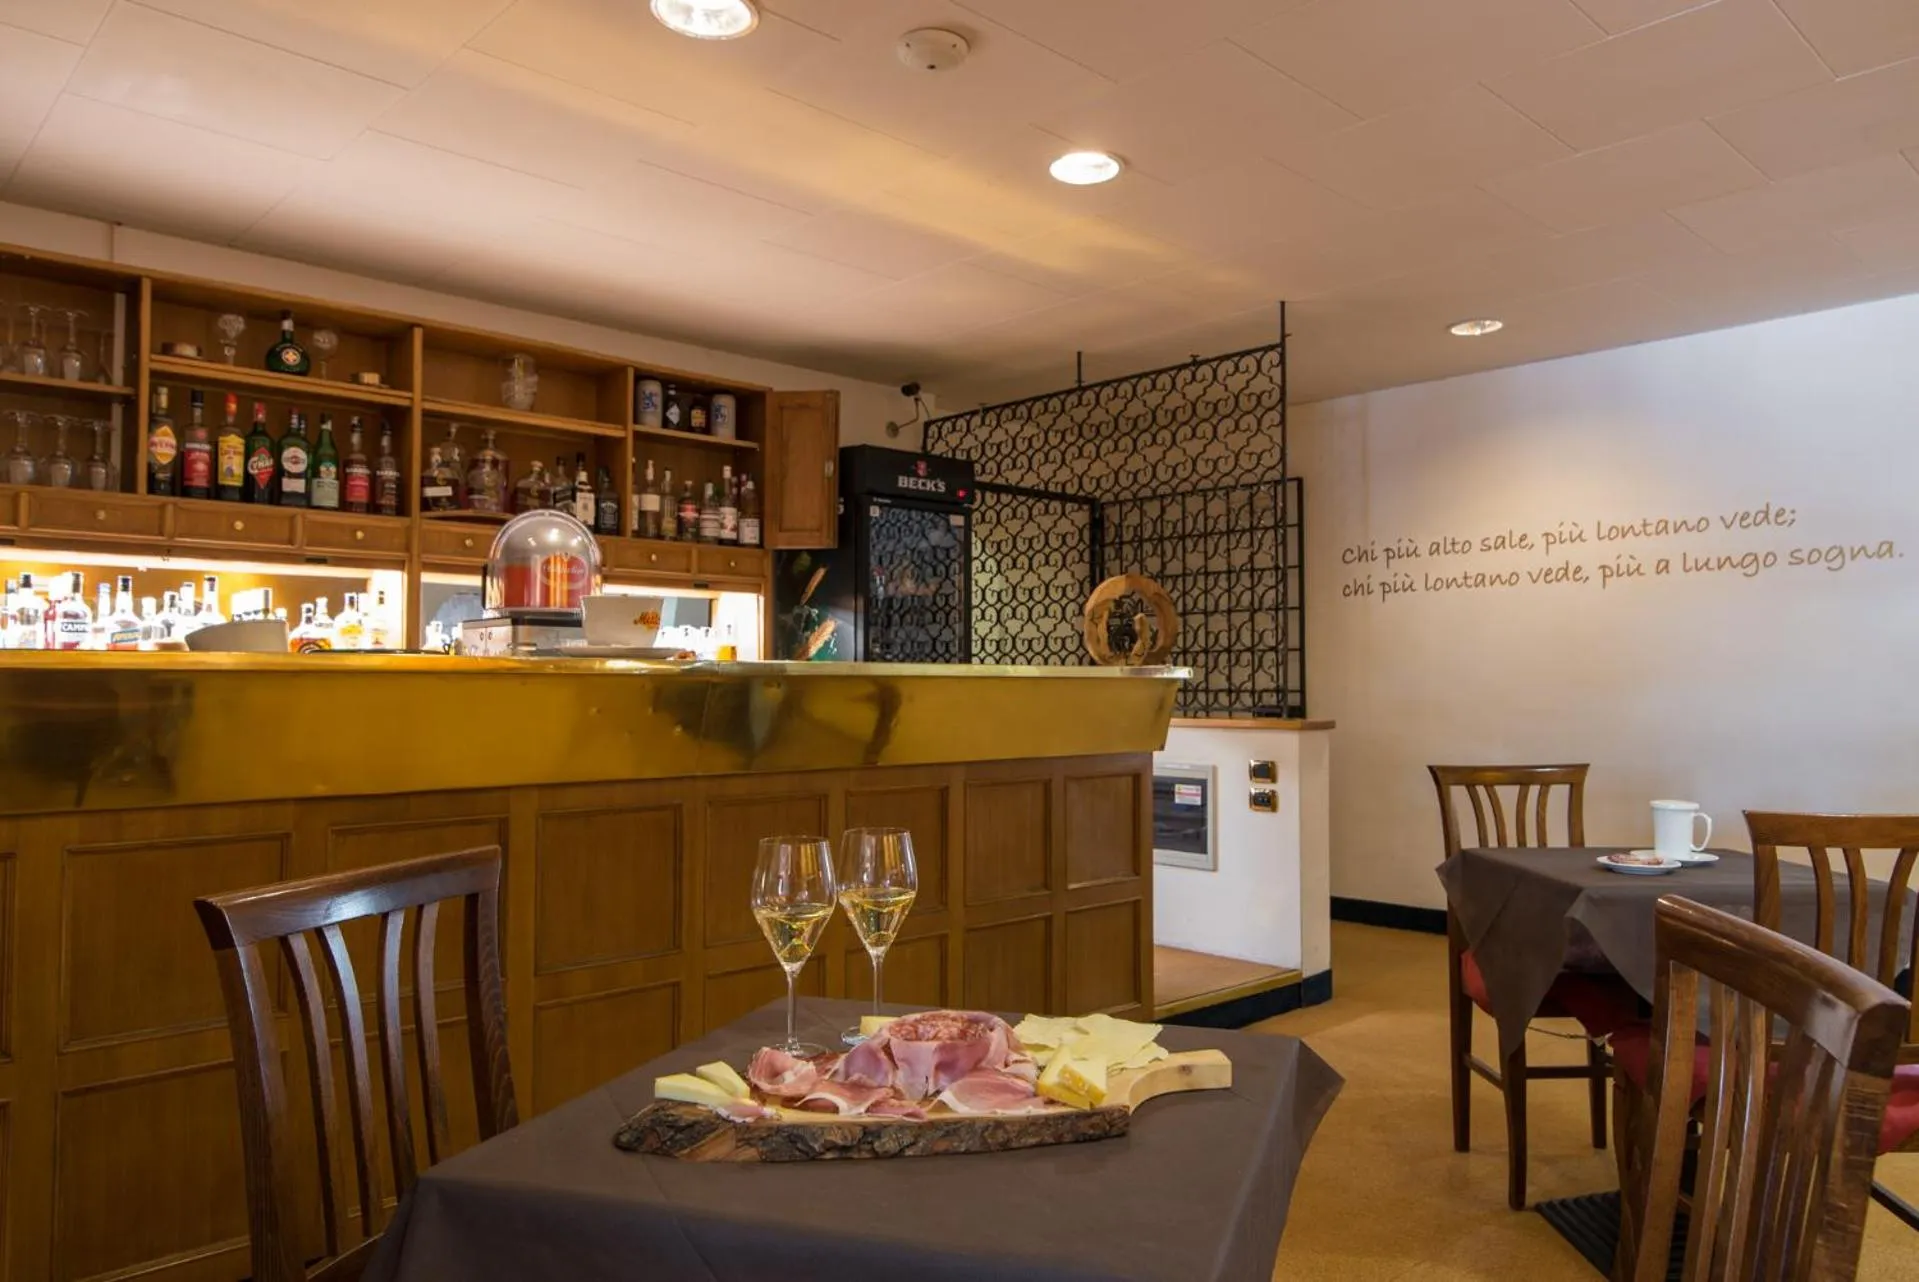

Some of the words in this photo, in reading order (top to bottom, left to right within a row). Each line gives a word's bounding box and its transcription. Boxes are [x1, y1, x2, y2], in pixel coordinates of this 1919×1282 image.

[897, 475, 946, 493] BECK'S
[1384, 537, 1422, 569] più
[1427, 536, 1473, 558] alto
[1479, 528, 1536, 553] sale,
[1541, 521, 1588, 556] più
[1596, 514, 1711, 542] lontano
[1719, 501, 1797, 530] vede;
[1379, 571, 1418, 603] più
[1423, 569, 1521, 593] lontano
[1526, 559, 1591, 585] vede,
[1597, 553, 1646, 590] più
[1655, 557, 1671, 576] a
[1681, 550, 1779, 578] lungo
[1787, 539, 1905, 572] sogna.
